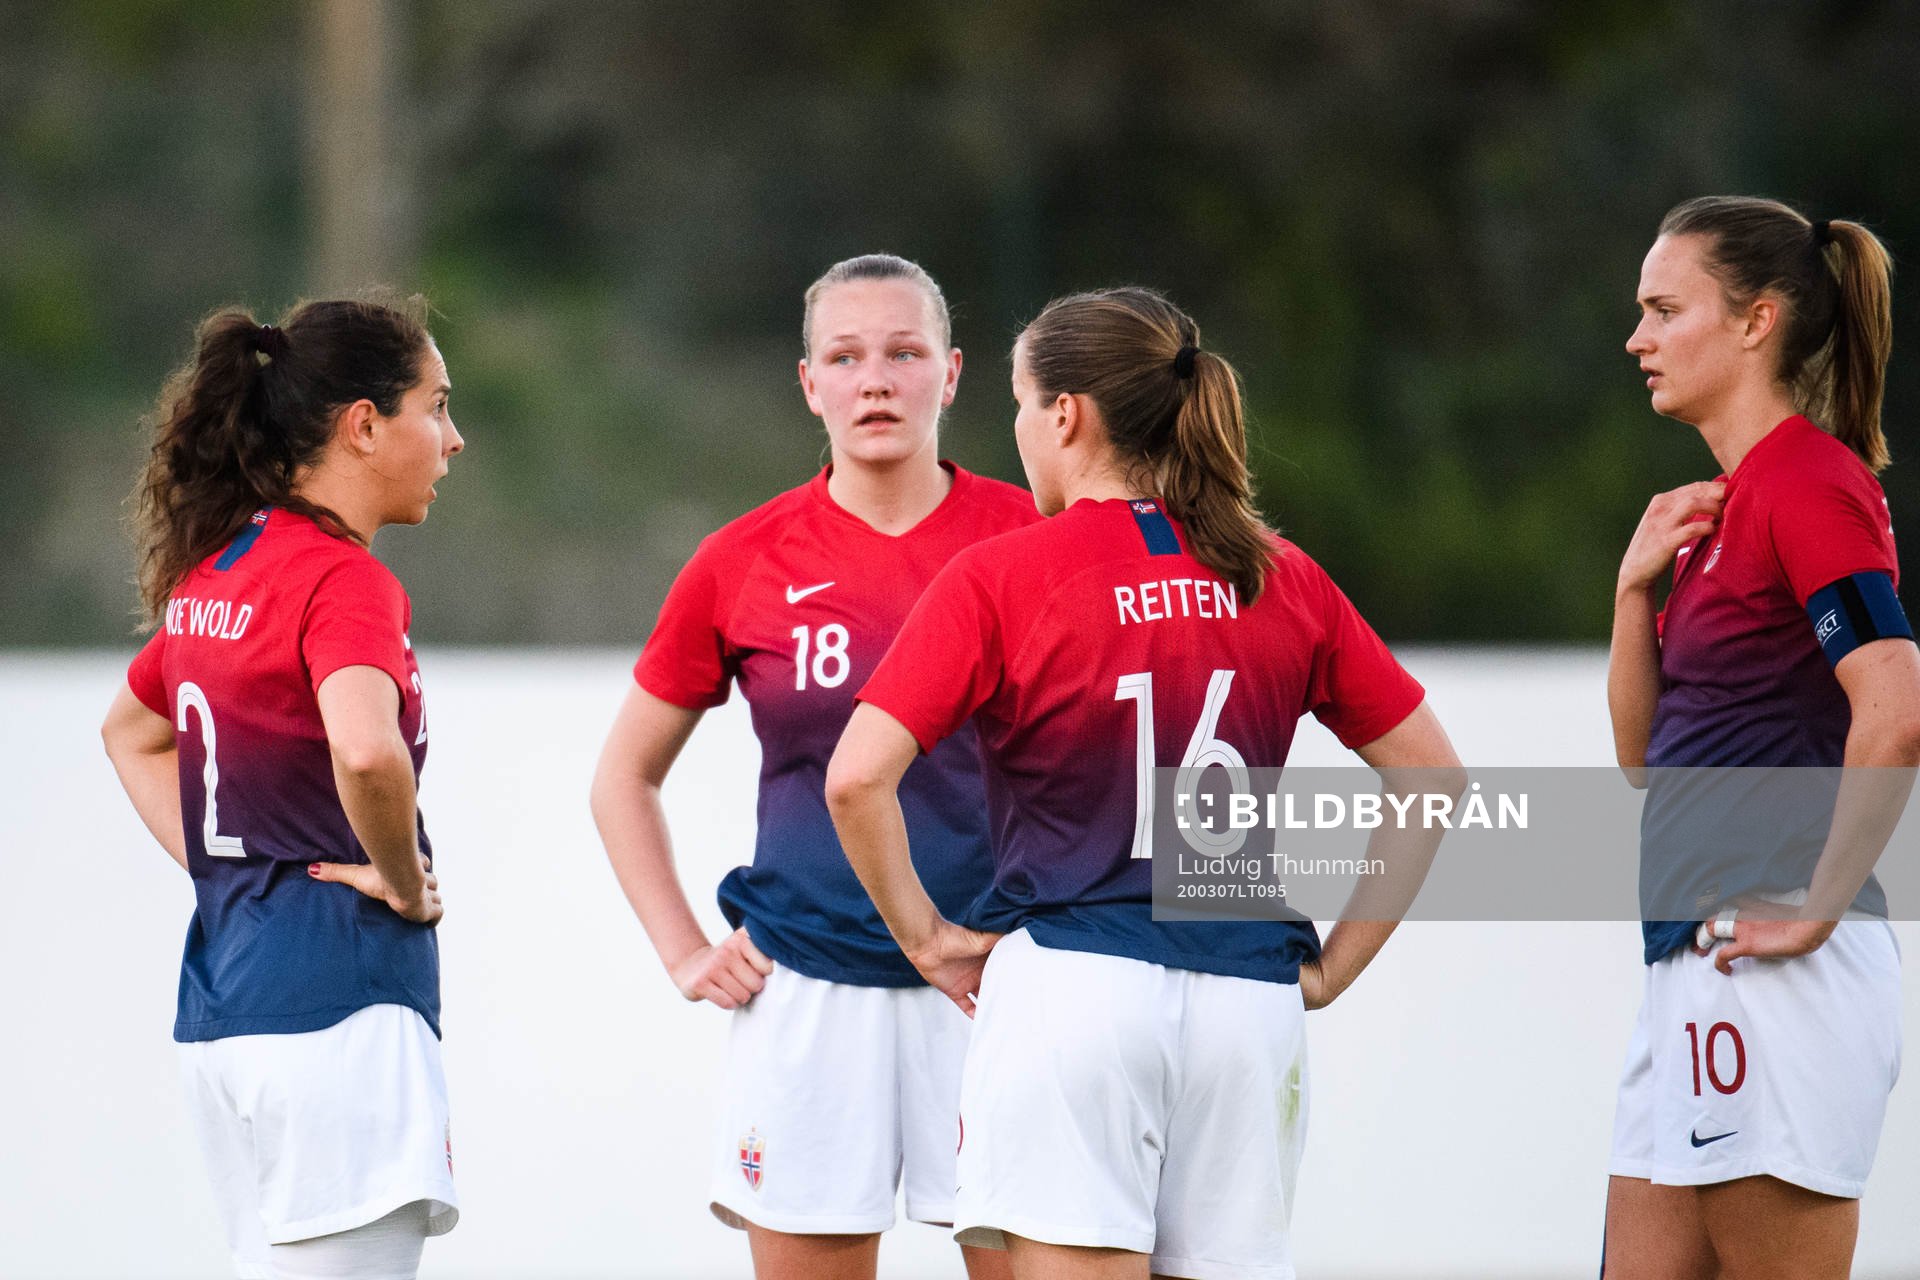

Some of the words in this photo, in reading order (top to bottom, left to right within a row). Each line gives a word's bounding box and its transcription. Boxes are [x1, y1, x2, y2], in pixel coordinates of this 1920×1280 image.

[190, 598, 253, 640] WOLD
[1114, 578, 1238, 625] REITEN
[791, 623, 850, 691] 18
[177, 681, 247, 858] 2
[1114, 669, 1250, 859] 16
[1685, 1021, 1746, 1096] 10
